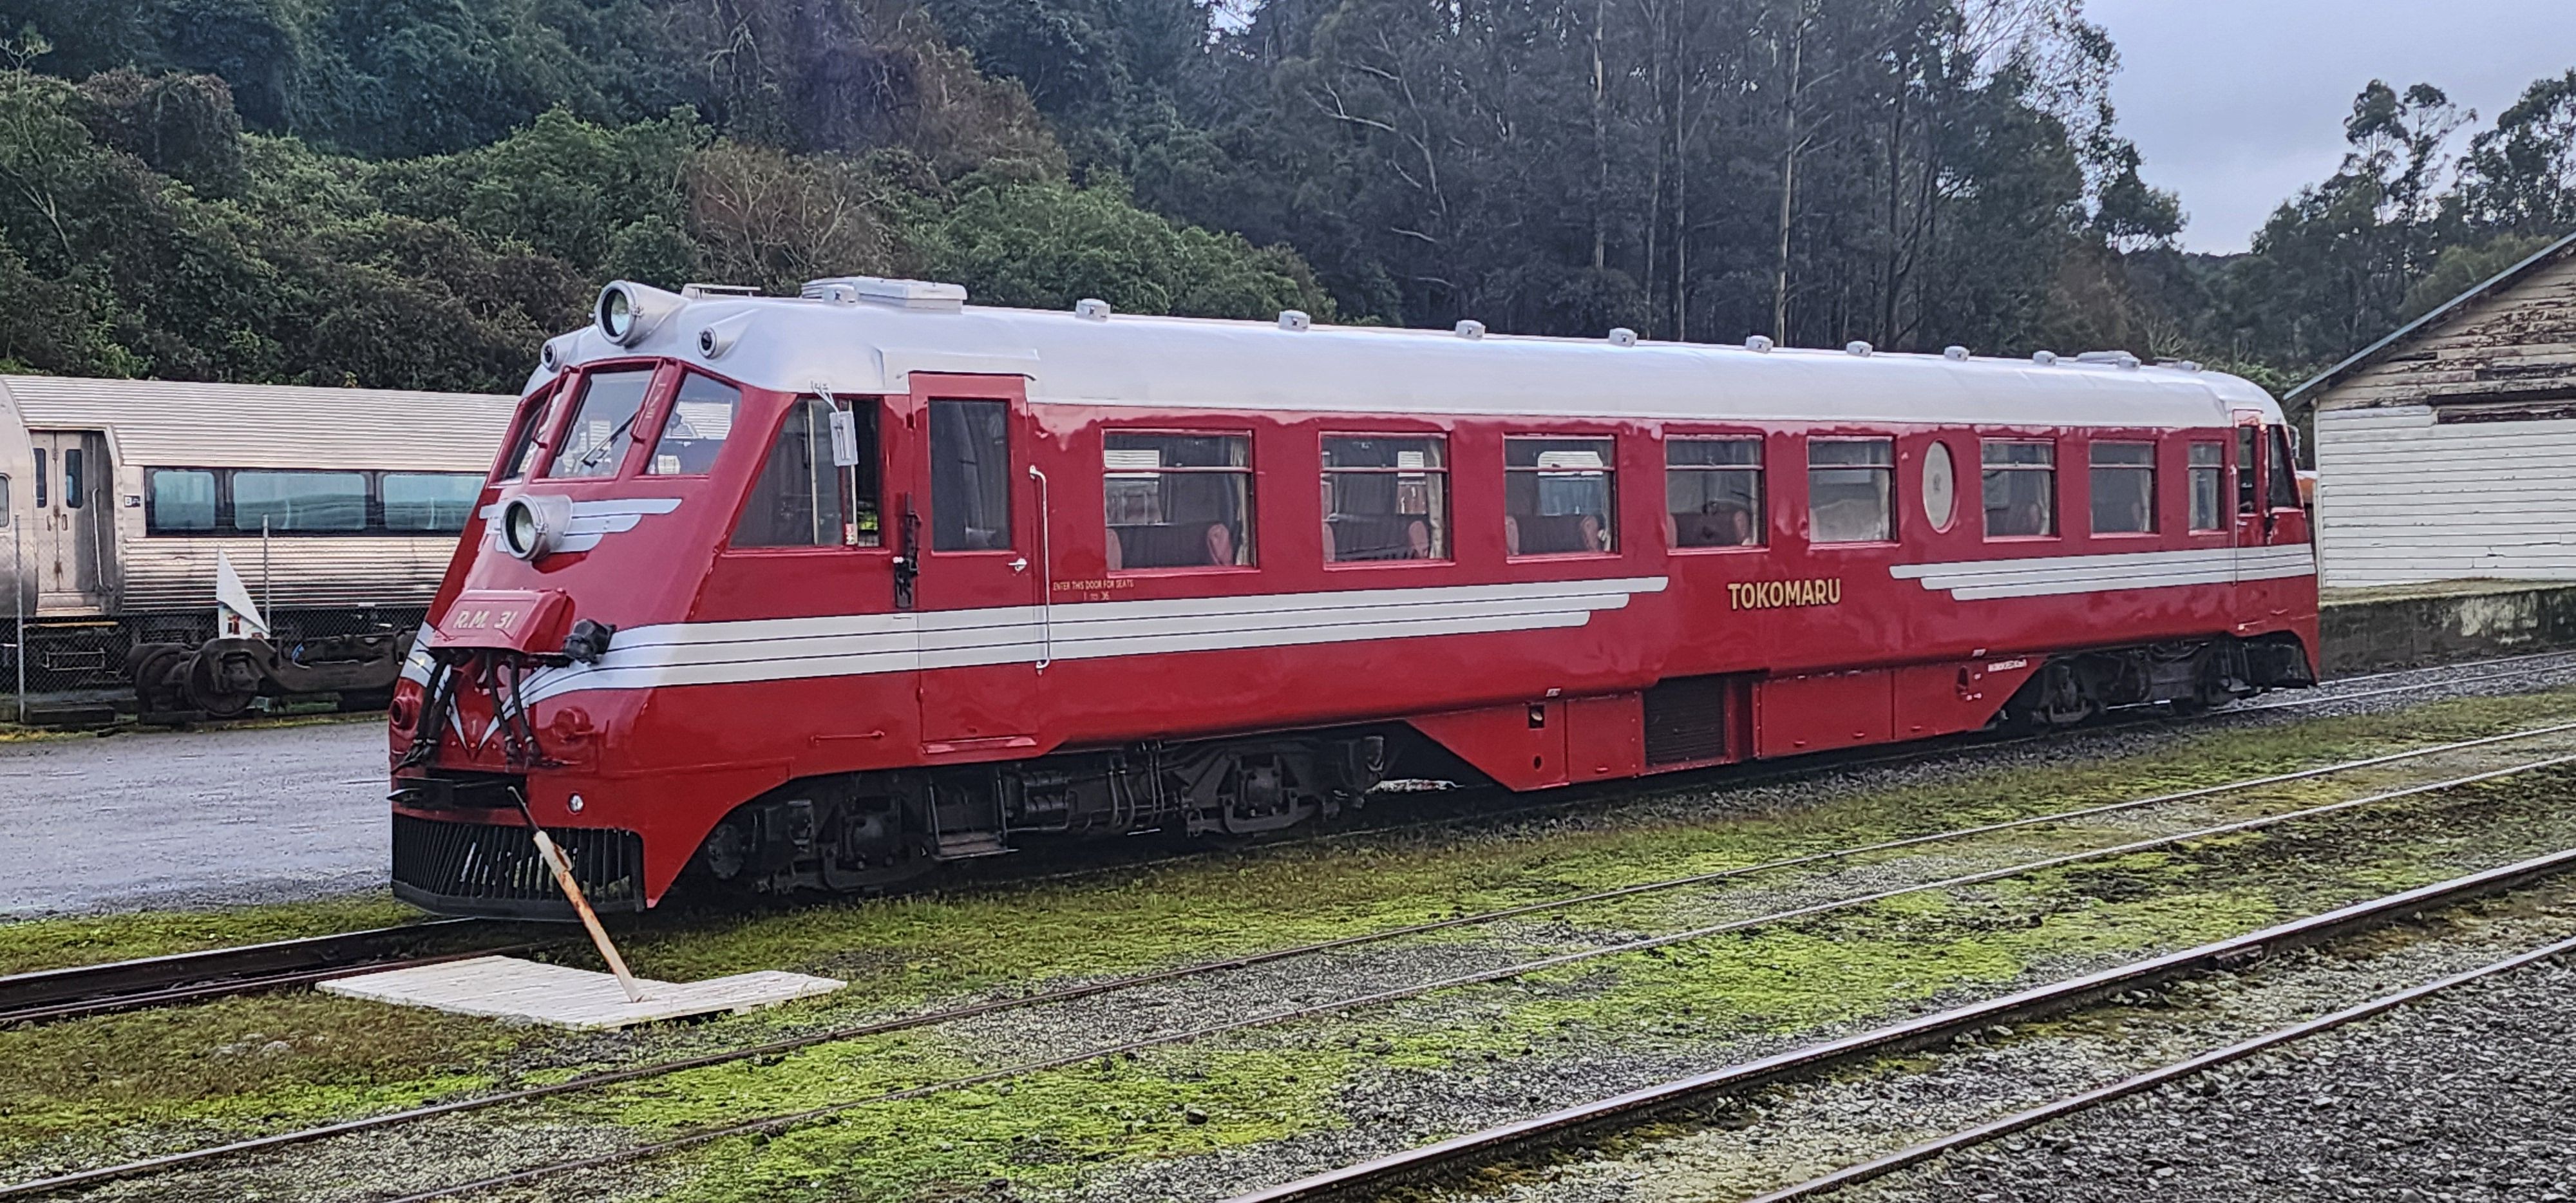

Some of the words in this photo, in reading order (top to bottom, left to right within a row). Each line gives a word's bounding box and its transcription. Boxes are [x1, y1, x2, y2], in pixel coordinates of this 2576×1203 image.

[1053, 582, 1070, 591] ENTER
[1071, 580, 1084, 590] THIS
[1085, 580, 1102, 590] DOOR
[1103, 579, 1114, 589] FOR
[1115, 579, 1134, 589] SEATS
[1727, 578, 1841, 610] TOKOMARU
[452, 610, 490, 629] R.M.
[493, 611, 518, 629] 31
